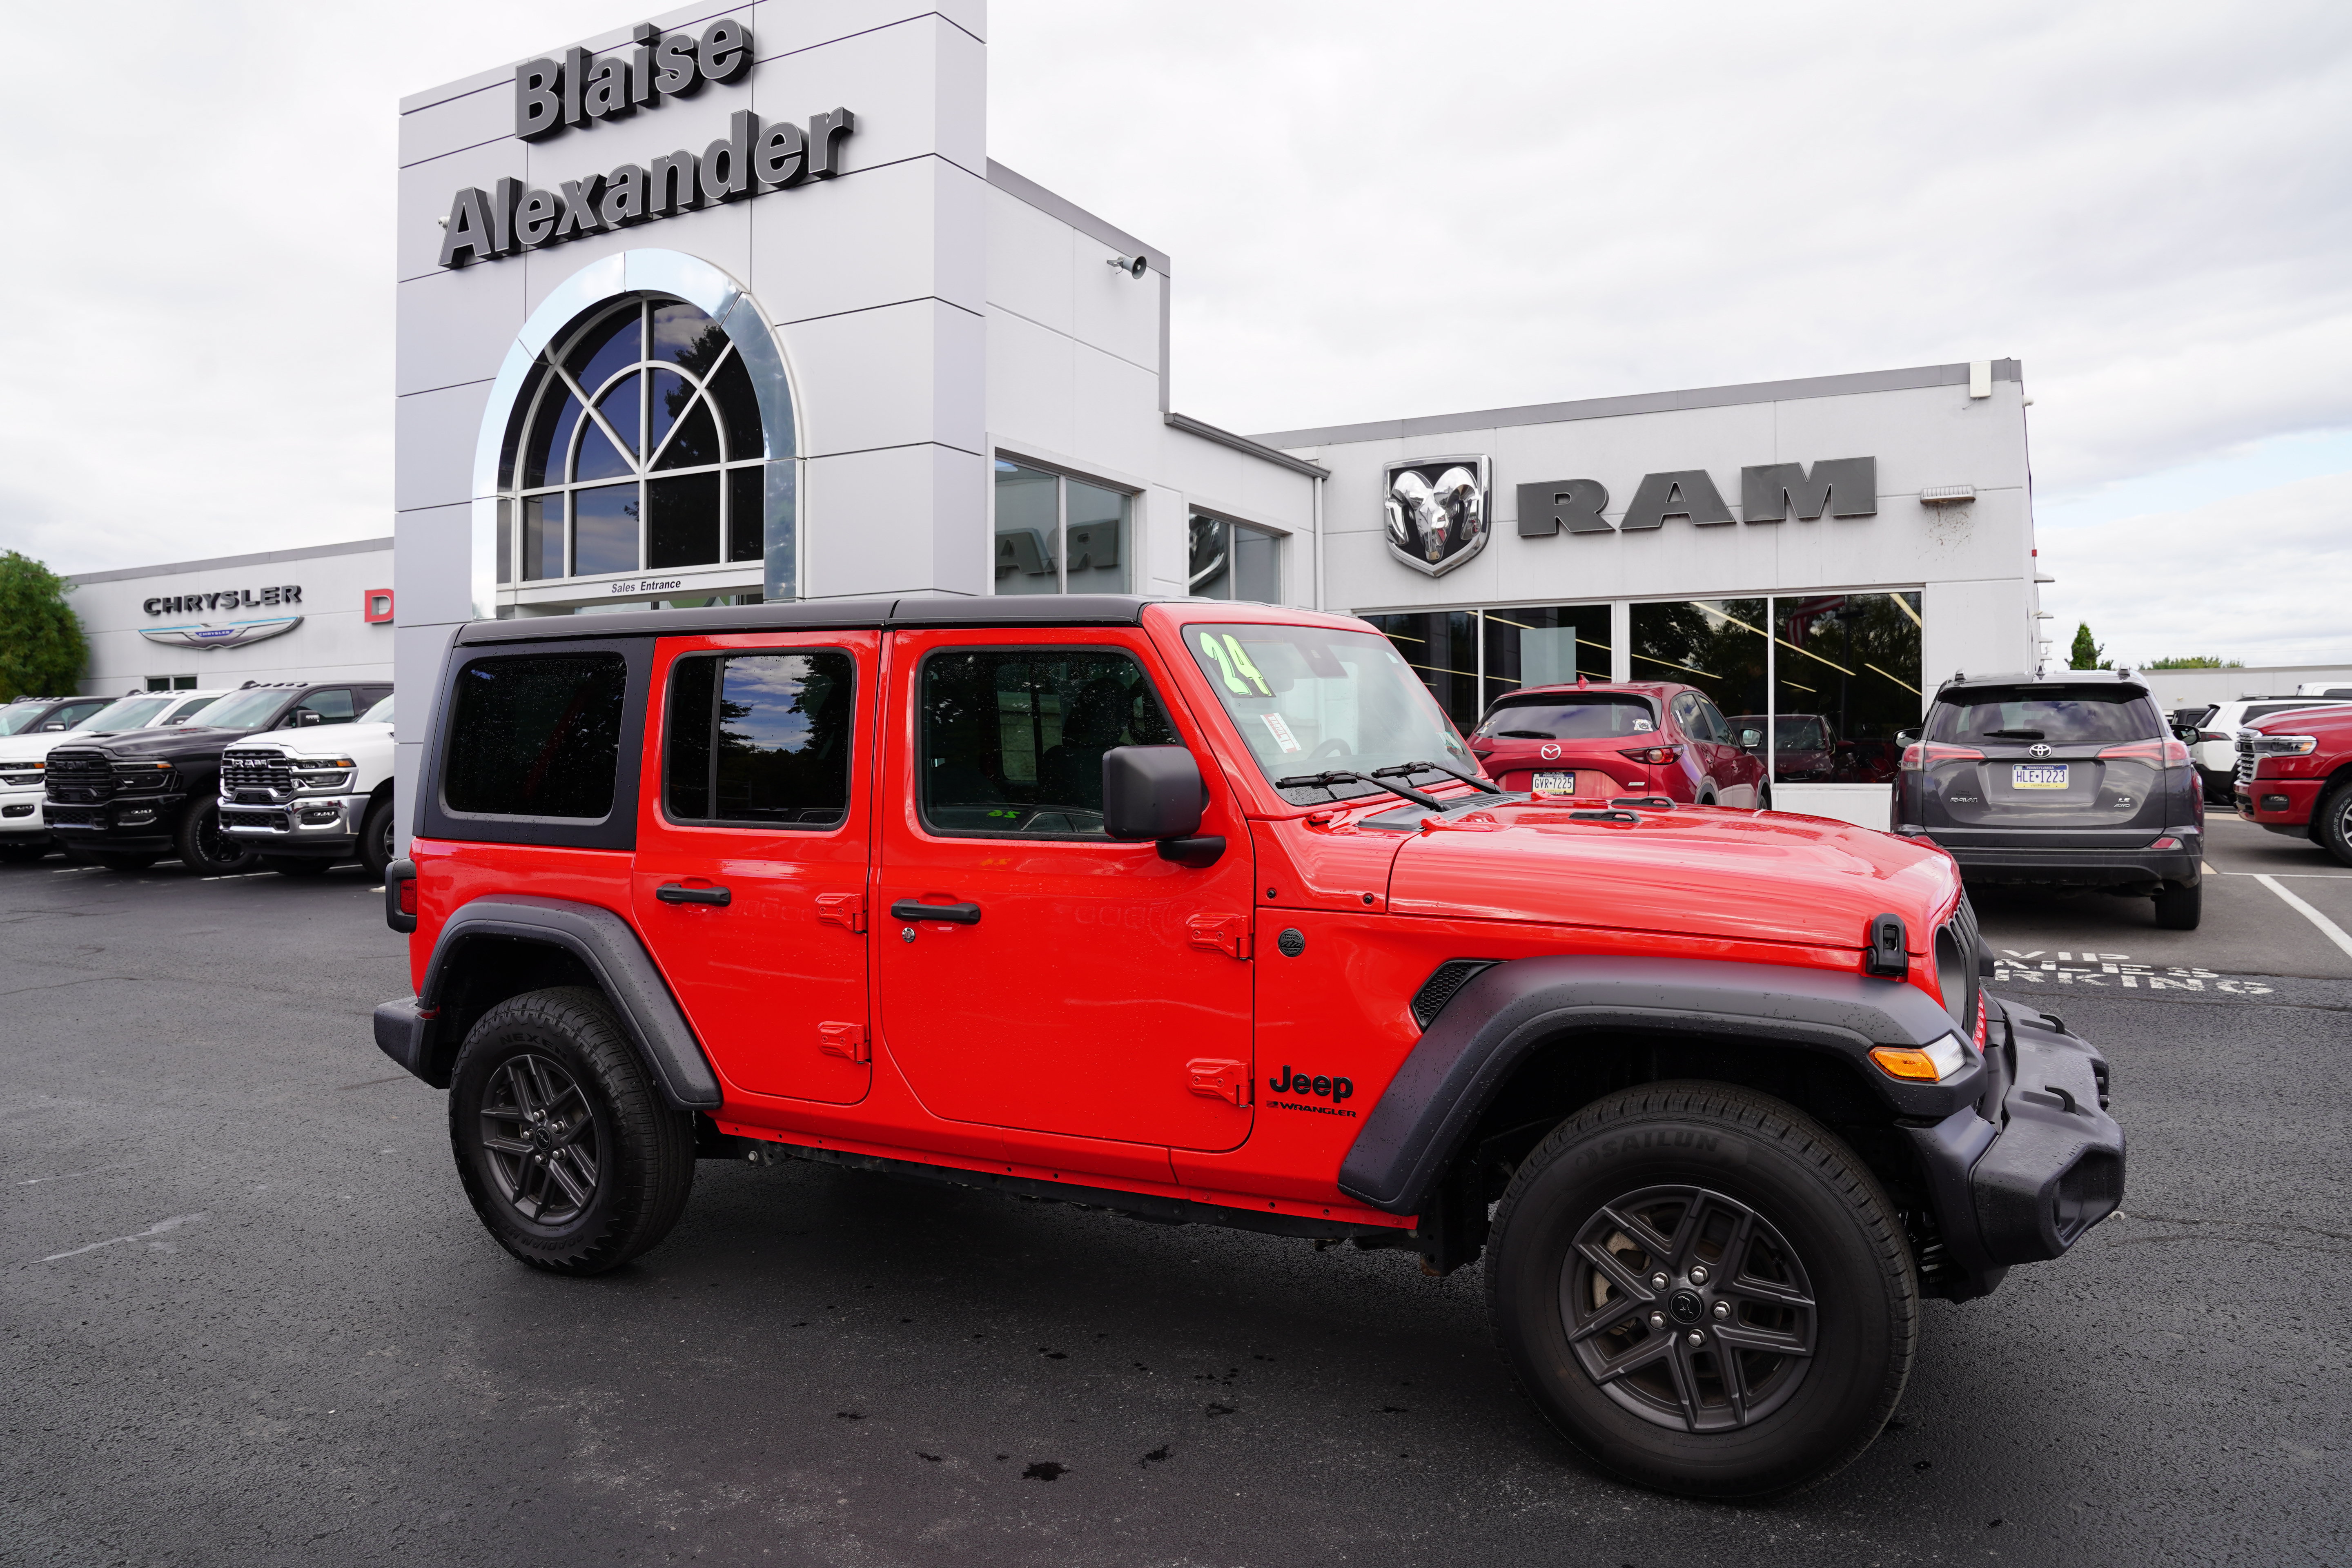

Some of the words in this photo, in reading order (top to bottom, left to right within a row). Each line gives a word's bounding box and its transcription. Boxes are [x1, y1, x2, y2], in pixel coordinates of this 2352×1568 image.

[515, 18, 754, 142] Blaise
[438, 107, 854, 269] Alexander
[1516, 456, 1877, 537] RAM
[143, 585, 302, 615] CHRYSLER
[612, 583, 635, 593] Sales
[640, 580, 681, 591] Entrance
[1200, 632, 1272, 696] 24
[233, 759, 267, 768] RAM
[1994, 958, 2219, 978] ALES
[2002, 950, 2130, 961] VIP
[1994, 969, 2274, 994] RKING
[499, 1033, 568, 1060] NEXEN
[1270, 1065, 1354, 1103] Jeep
[1280, 1102, 1357, 1118] WRANGLER
[1601, 1131, 1720, 1158] SAILUN
